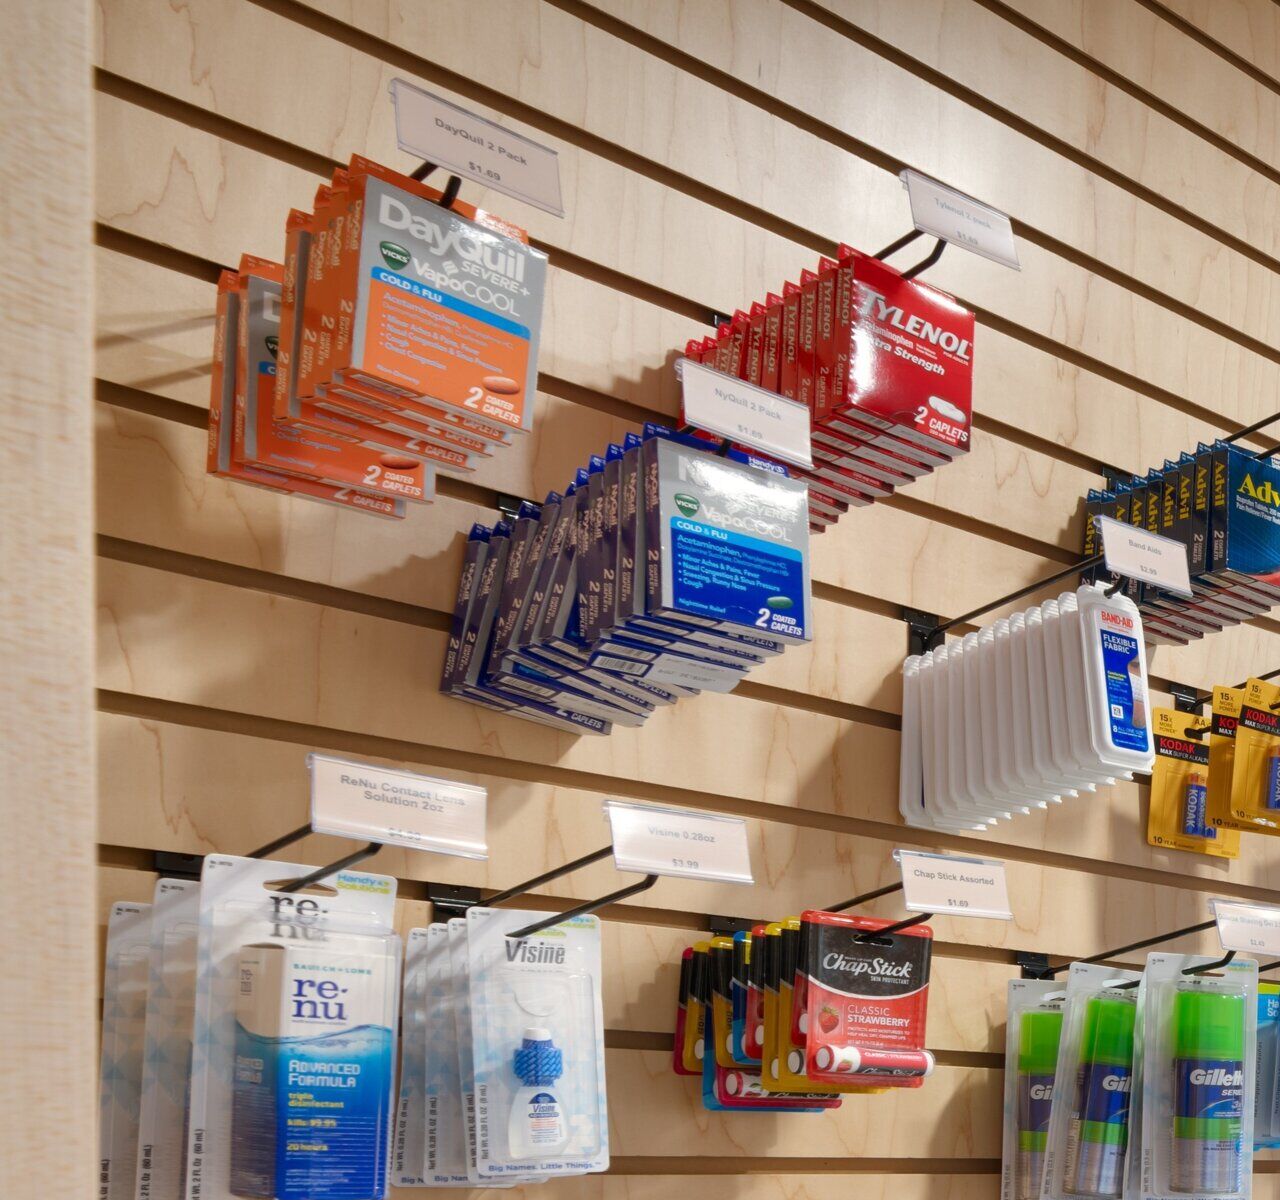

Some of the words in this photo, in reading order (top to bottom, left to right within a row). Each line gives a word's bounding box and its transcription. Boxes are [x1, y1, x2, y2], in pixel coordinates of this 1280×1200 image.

[435, 117, 484, 147] DayQuil
[488, 141, 495, 151] 2
[498, 145, 527, 166] Pack
[469, 161, 501, 181] $1.69
[379, 194, 525, 281] DayQuil
[381, 247, 409, 264] VICKS
[380, 273, 411, 290] COLD
[413, 285, 420, 294] &
[422, 289, 442, 303] FLU
[413, 258, 520, 316] VapoCOOL
[860, 289, 972, 361] TYLENOL
[464, 386, 483, 408] 2
[486, 395, 514, 411] COATED
[482, 404, 521, 424] CAPLETS
[1128, 539, 1145, 551] Band
[1147, 544, 1162, 556] Aids
[1101, 610, 1134, 629] BAND-AID
[1103, 633, 1137, 649] FLEXIBLE
[1104, 642, 1130, 654] FABRIC
[1246, 709, 1278, 727] KODAK
[1159, 737, 1195, 754] KODAK
[340, 775, 378, 791] ReNu
[381, 782, 431, 800] Contact
[434, 792, 466, 806] Lens
[364, 790, 418, 809] Solution
[422, 800, 444, 813] 2oz
[1186, 789, 1198, 828] KODAK
[648, 827, 681, 839] Visine
[683, 831, 716, 844] 0.28oz
[672, 858, 699, 870] $3.99
[337, 873, 376, 887] Handy
[913, 869, 936, 880] Chap
[937, 871, 957, 881] Stick
[960, 875, 994, 886] Assorted
[337, 881, 390, 894] Solutions
[505, 940, 566, 965] Visine
[823, 952, 913, 979] ChapStick
[292, 999, 346, 1020] nu
[848, 1004, 890, 1016] CLASSIC
[848, 1014, 910, 1027] STRAWBERRY
[288, 1060, 360, 1076] ADVANCED
[288, 1073, 356, 1088] FORMULA
